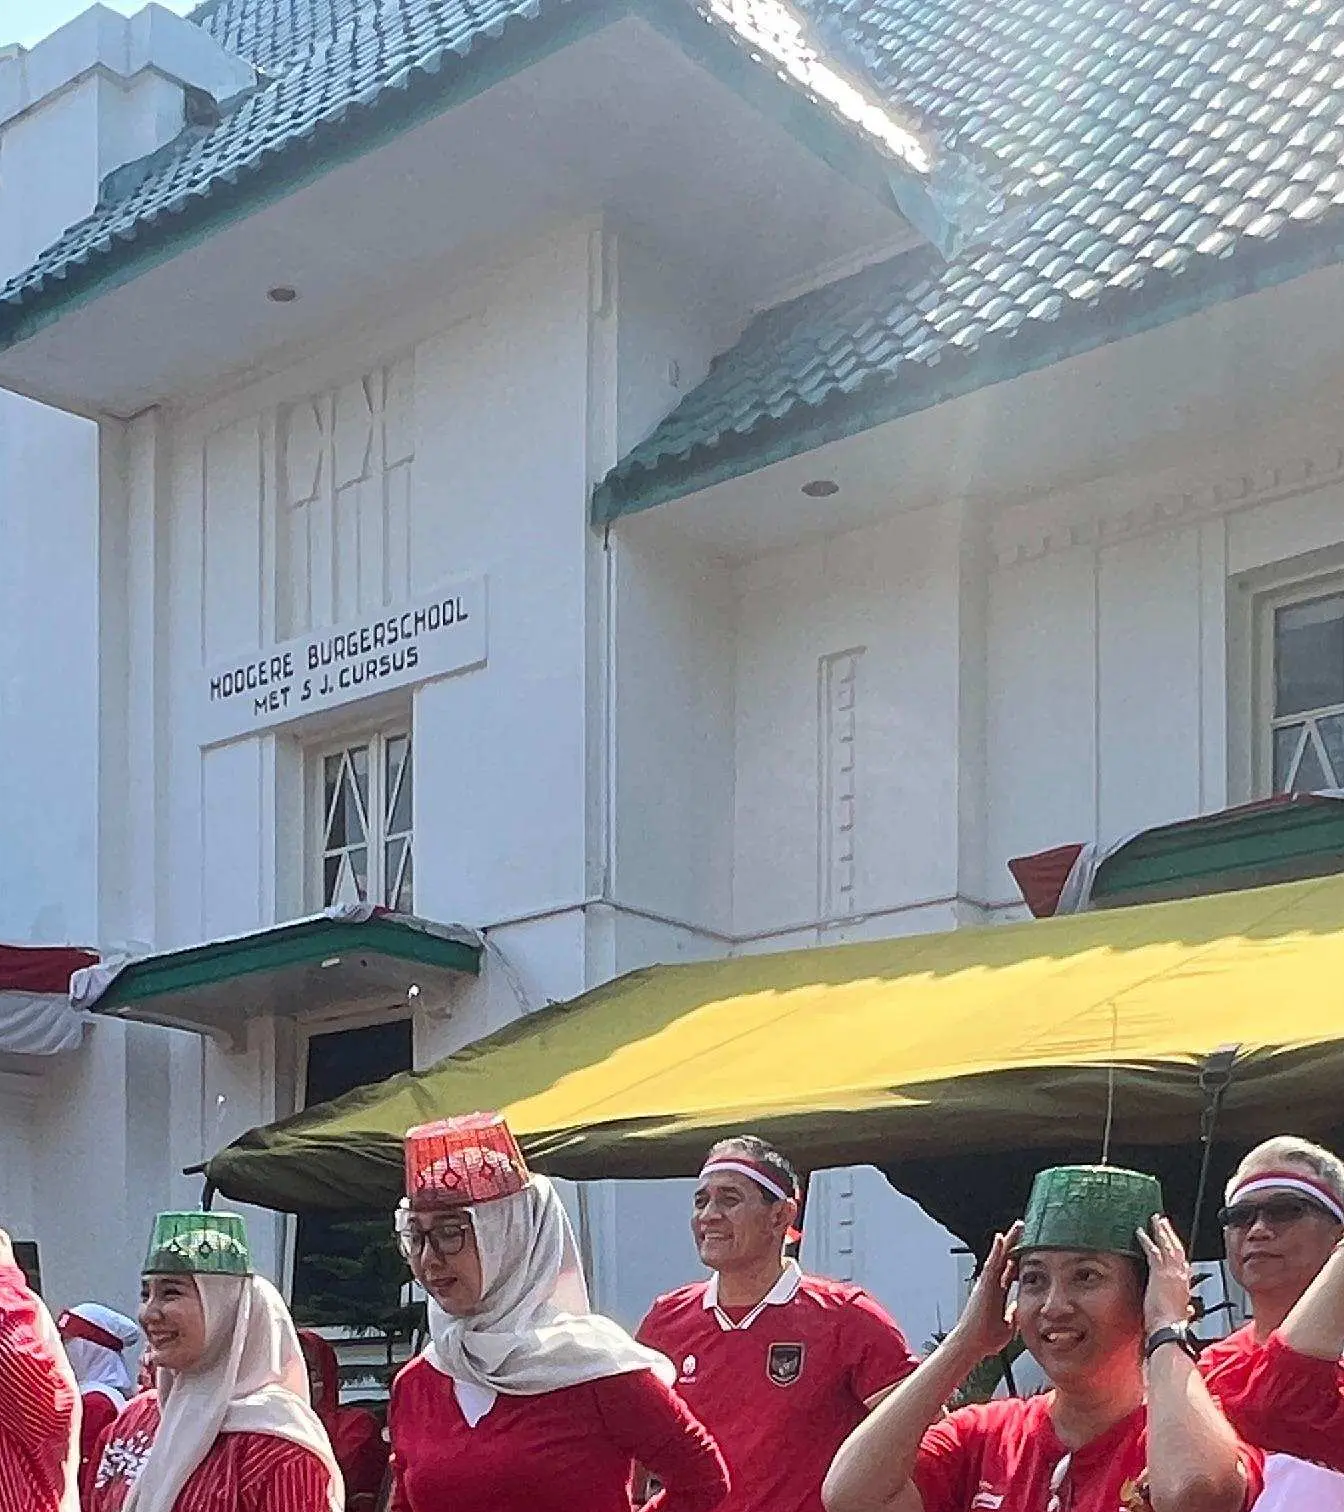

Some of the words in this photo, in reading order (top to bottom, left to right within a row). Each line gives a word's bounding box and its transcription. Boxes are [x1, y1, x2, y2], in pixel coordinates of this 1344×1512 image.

[210, 652, 294, 701] HOOGERE
[307, 596, 469, 670] BURGERSCHOOL
[255, 687, 290, 716] MET
[339, 645, 418, 688] CURSUS
